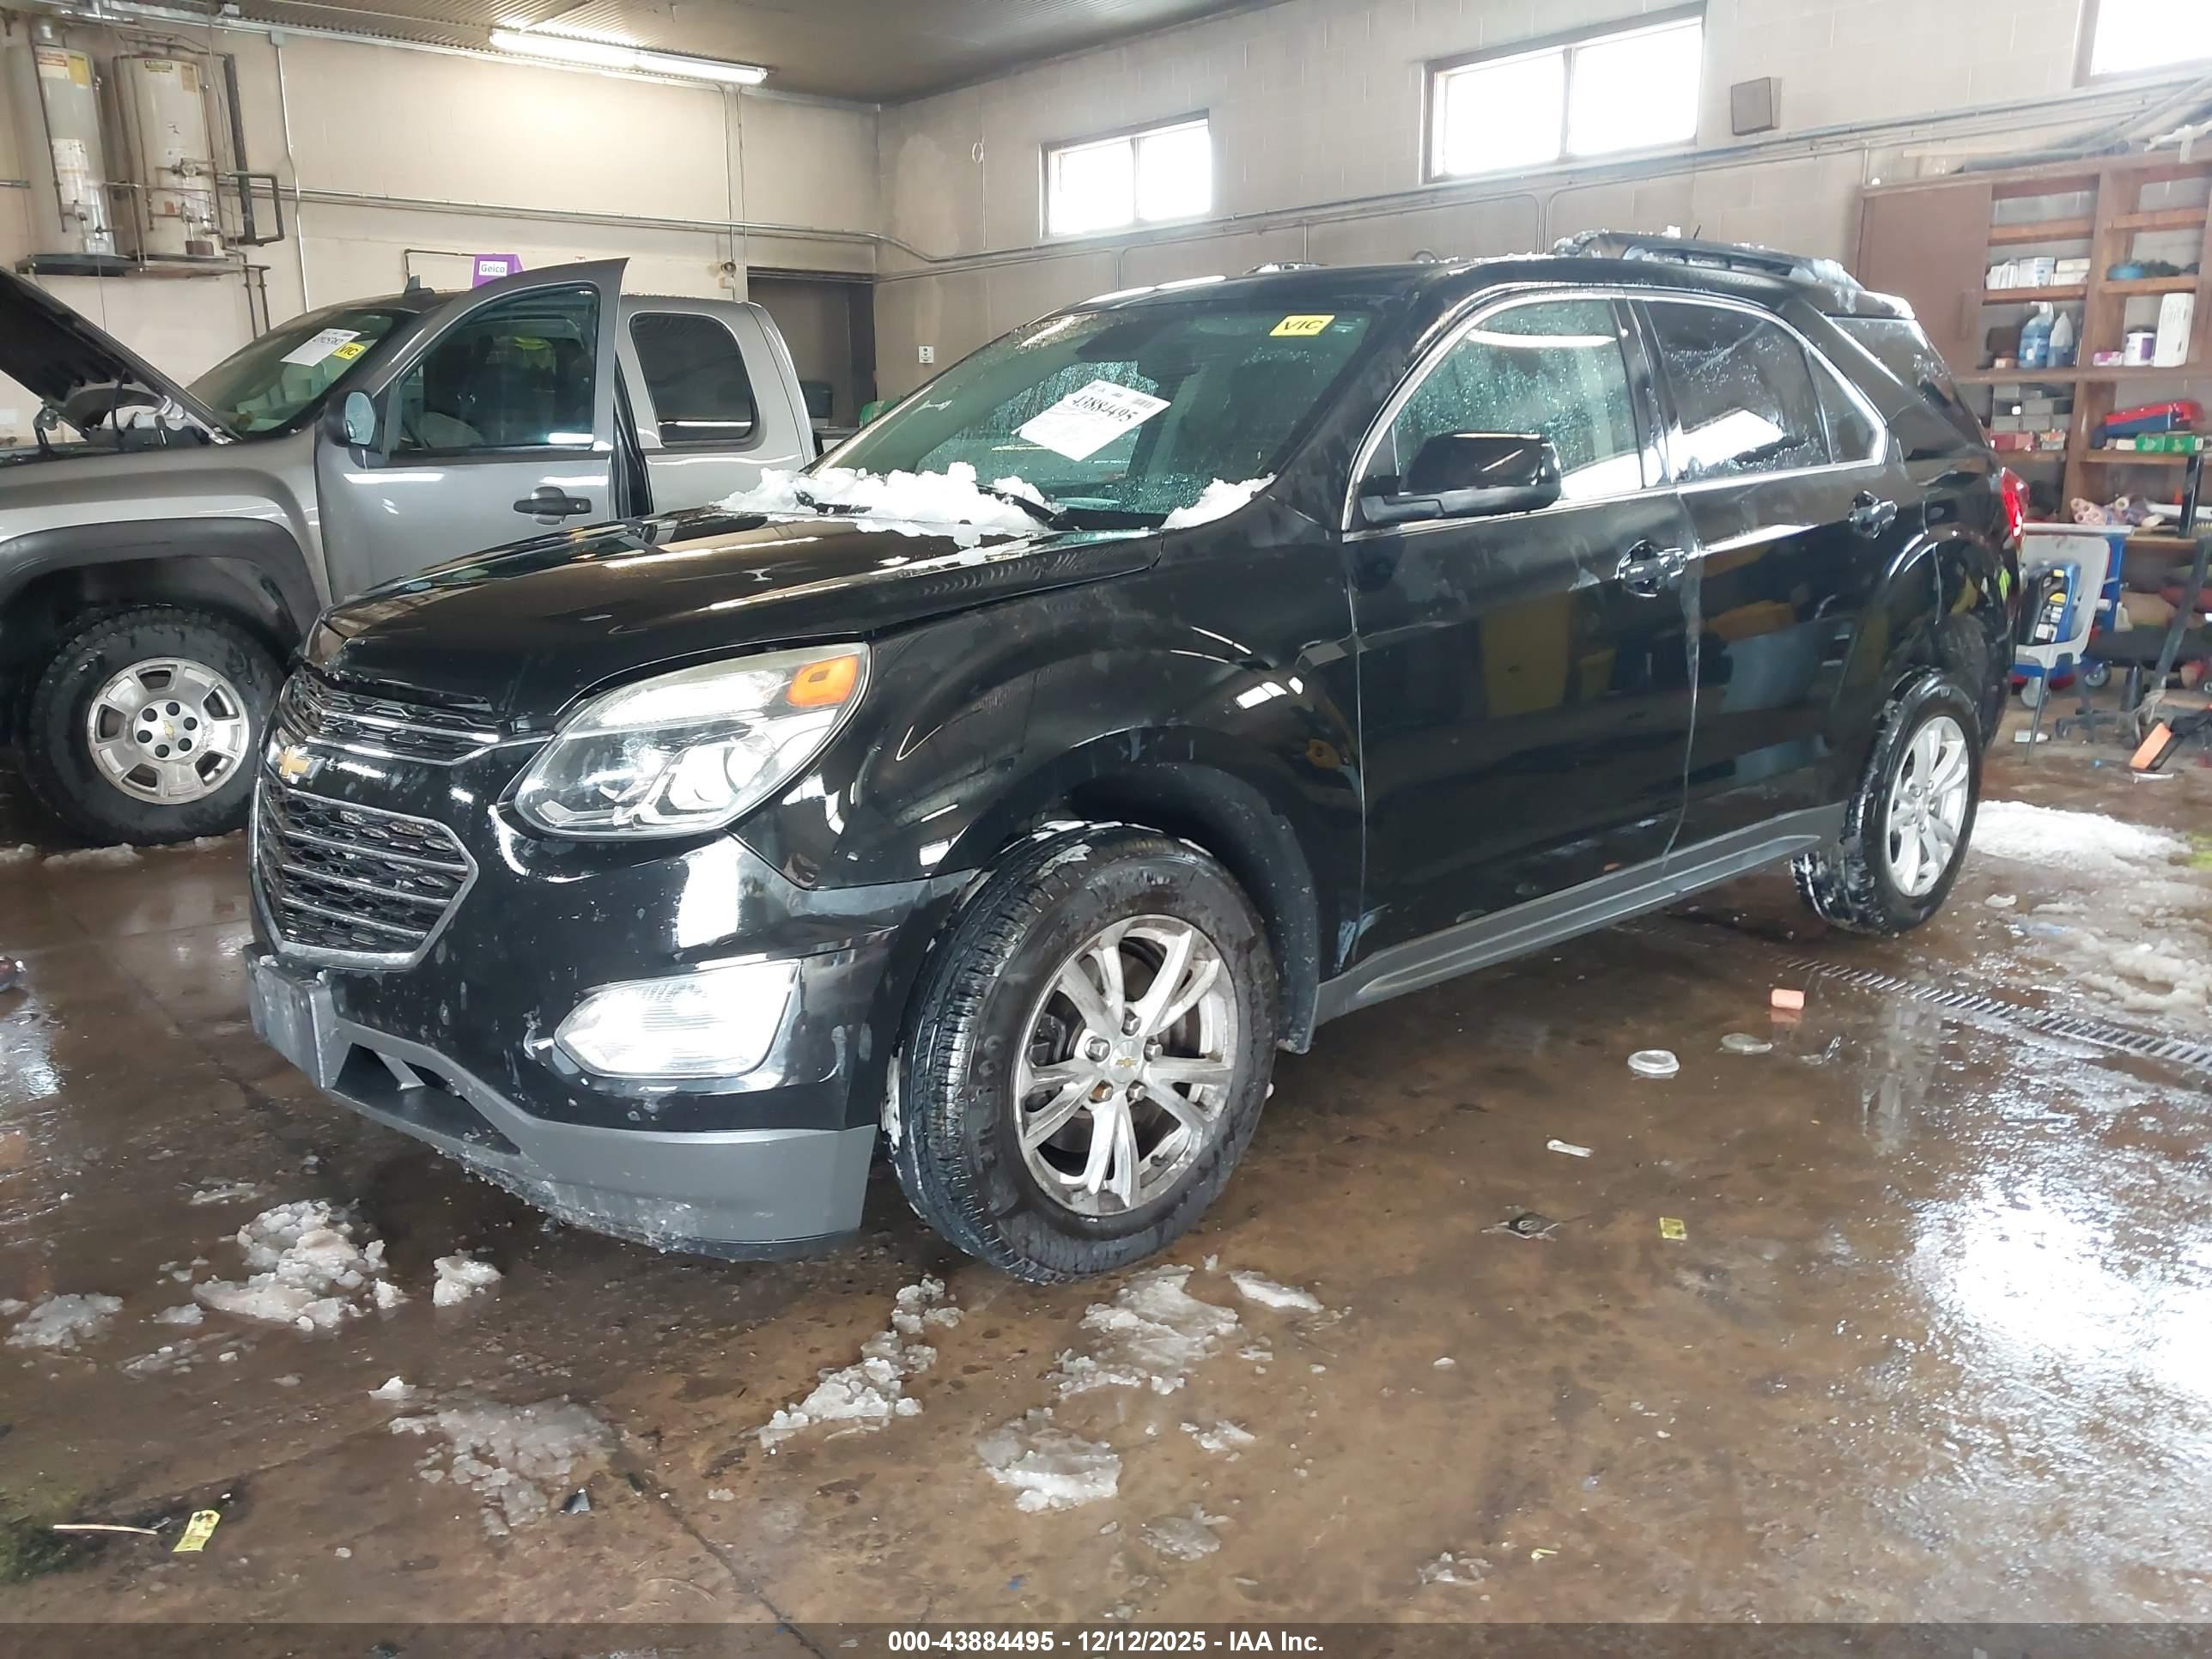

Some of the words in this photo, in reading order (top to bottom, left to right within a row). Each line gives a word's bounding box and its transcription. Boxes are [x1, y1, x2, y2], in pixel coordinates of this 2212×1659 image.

[481, 264, 506, 273] Geico
[1284, 320, 1323, 331] VIC
[339, 345, 358, 356] VIC
[1072, 395, 1139, 422] 43884495
